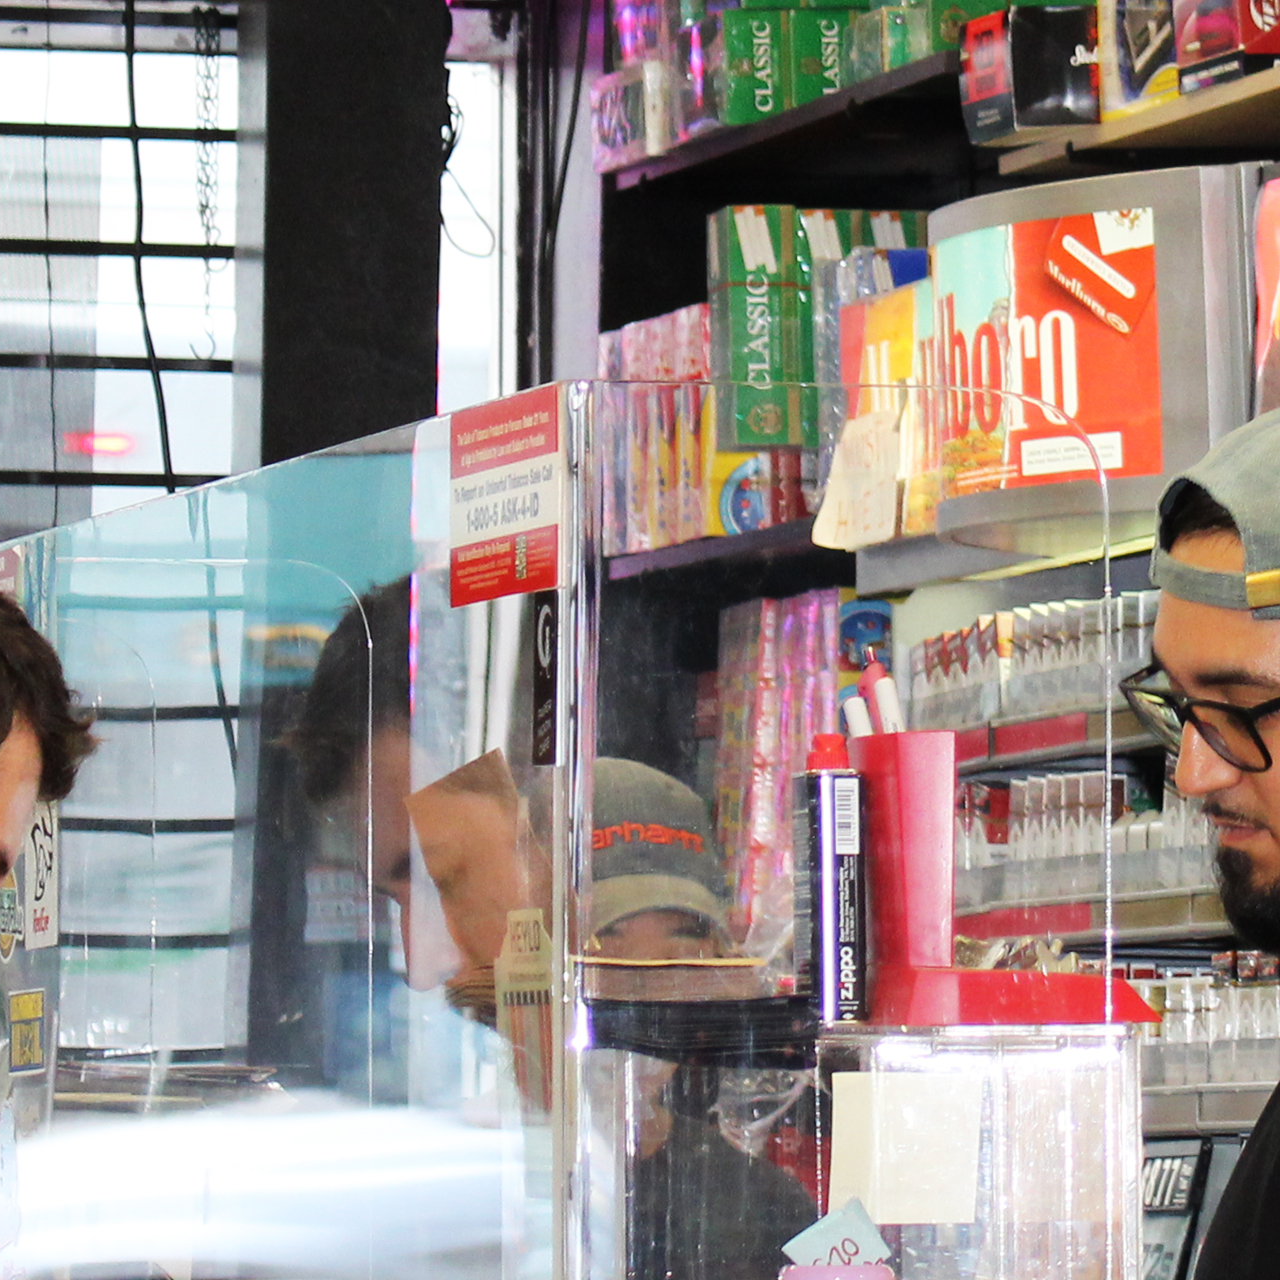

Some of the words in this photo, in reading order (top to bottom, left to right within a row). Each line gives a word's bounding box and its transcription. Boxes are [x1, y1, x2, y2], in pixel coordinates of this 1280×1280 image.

[753, 20, 775, 113] CLASSIC
[820, 19, 840, 95] LASSIC
[1047, 258, 1108, 319] Marlboro
[746, 268, 771, 390] CLASSIC
[501, 490, 540, 526] ASK-4-ID
[591, 820, 705, 854] arhartt
[840, 946, 857, 1001] zippo
